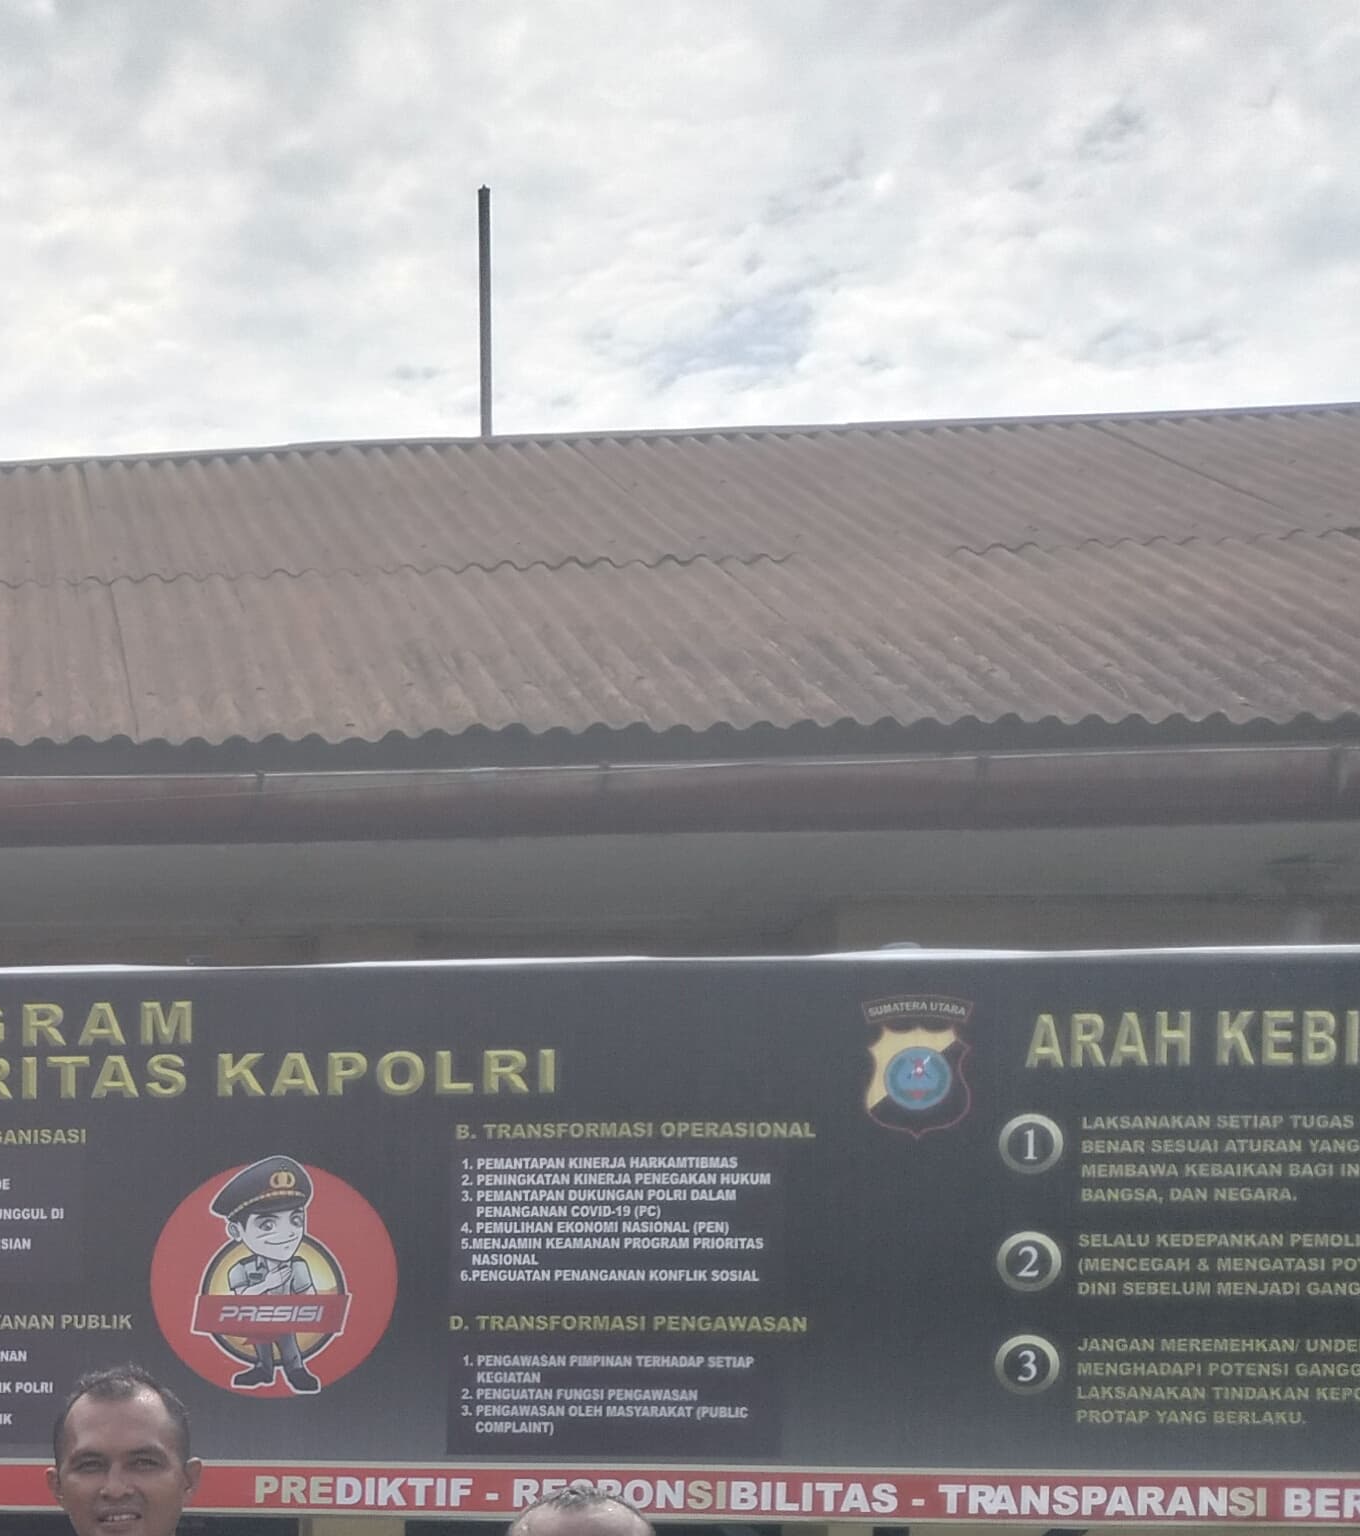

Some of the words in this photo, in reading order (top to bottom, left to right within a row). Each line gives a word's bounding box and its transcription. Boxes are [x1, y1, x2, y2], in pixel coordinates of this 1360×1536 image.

[868, 1001, 927, 1016] SUMATERA
[930, 1002, 965, 1015] UTARA
[1025, 1012, 1191, 1067] ARAH
[216, 1049, 556, 1097] KAPOLRI
[456, 1125, 476, 1140] B.
[485, 1123, 653, 1139] TRANSFORMASI
[662, 1122, 816, 1137] OPERASIONAL
[1082, 1115, 1211, 1129] LAKSANAKAN
[1218, 1115, 1284, 1129] SETIAP
[1290, 1115, 1354, 1129] TUGAS
[1024, 1128, 1038, 1160] 1
[461, 1174, 472, 1186] 2.
[477, 1174, 570, 1186] PENINGKATAN
[574, 1173, 632, 1185] KINERJA
[636, 1173, 717, 1185] PENEGAKAN
[721, 1173, 771, 1185] HUKUM
[51, 1207, 64, 1220] DI
[1018, 1246, 1039, 1277] 2
[555, 1269, 644, 1282] PENANGANAN
[649, 1269, 707, 1281] KONFLIK
[711, 1269, 759, 1281] SOSIAL
[61, 1313, 132, 1329] PUBLIK
[218, 1304, 324, 1323] PRESISI
[450, 1315, 468, 1331] D.
[477, 1315, 644, 1331] TRANSFORMASI
[654, 1315, 807, 1331] PENGAWASAN
[1019, 1351, 1038, 1381] 3
[254, 1475, 473, 1507] PREDIKTIF
[513, 1478, 898, 1513] RPONSIBILITAS
[938, 1484, 1267, 1517] TRANSPARANSI
